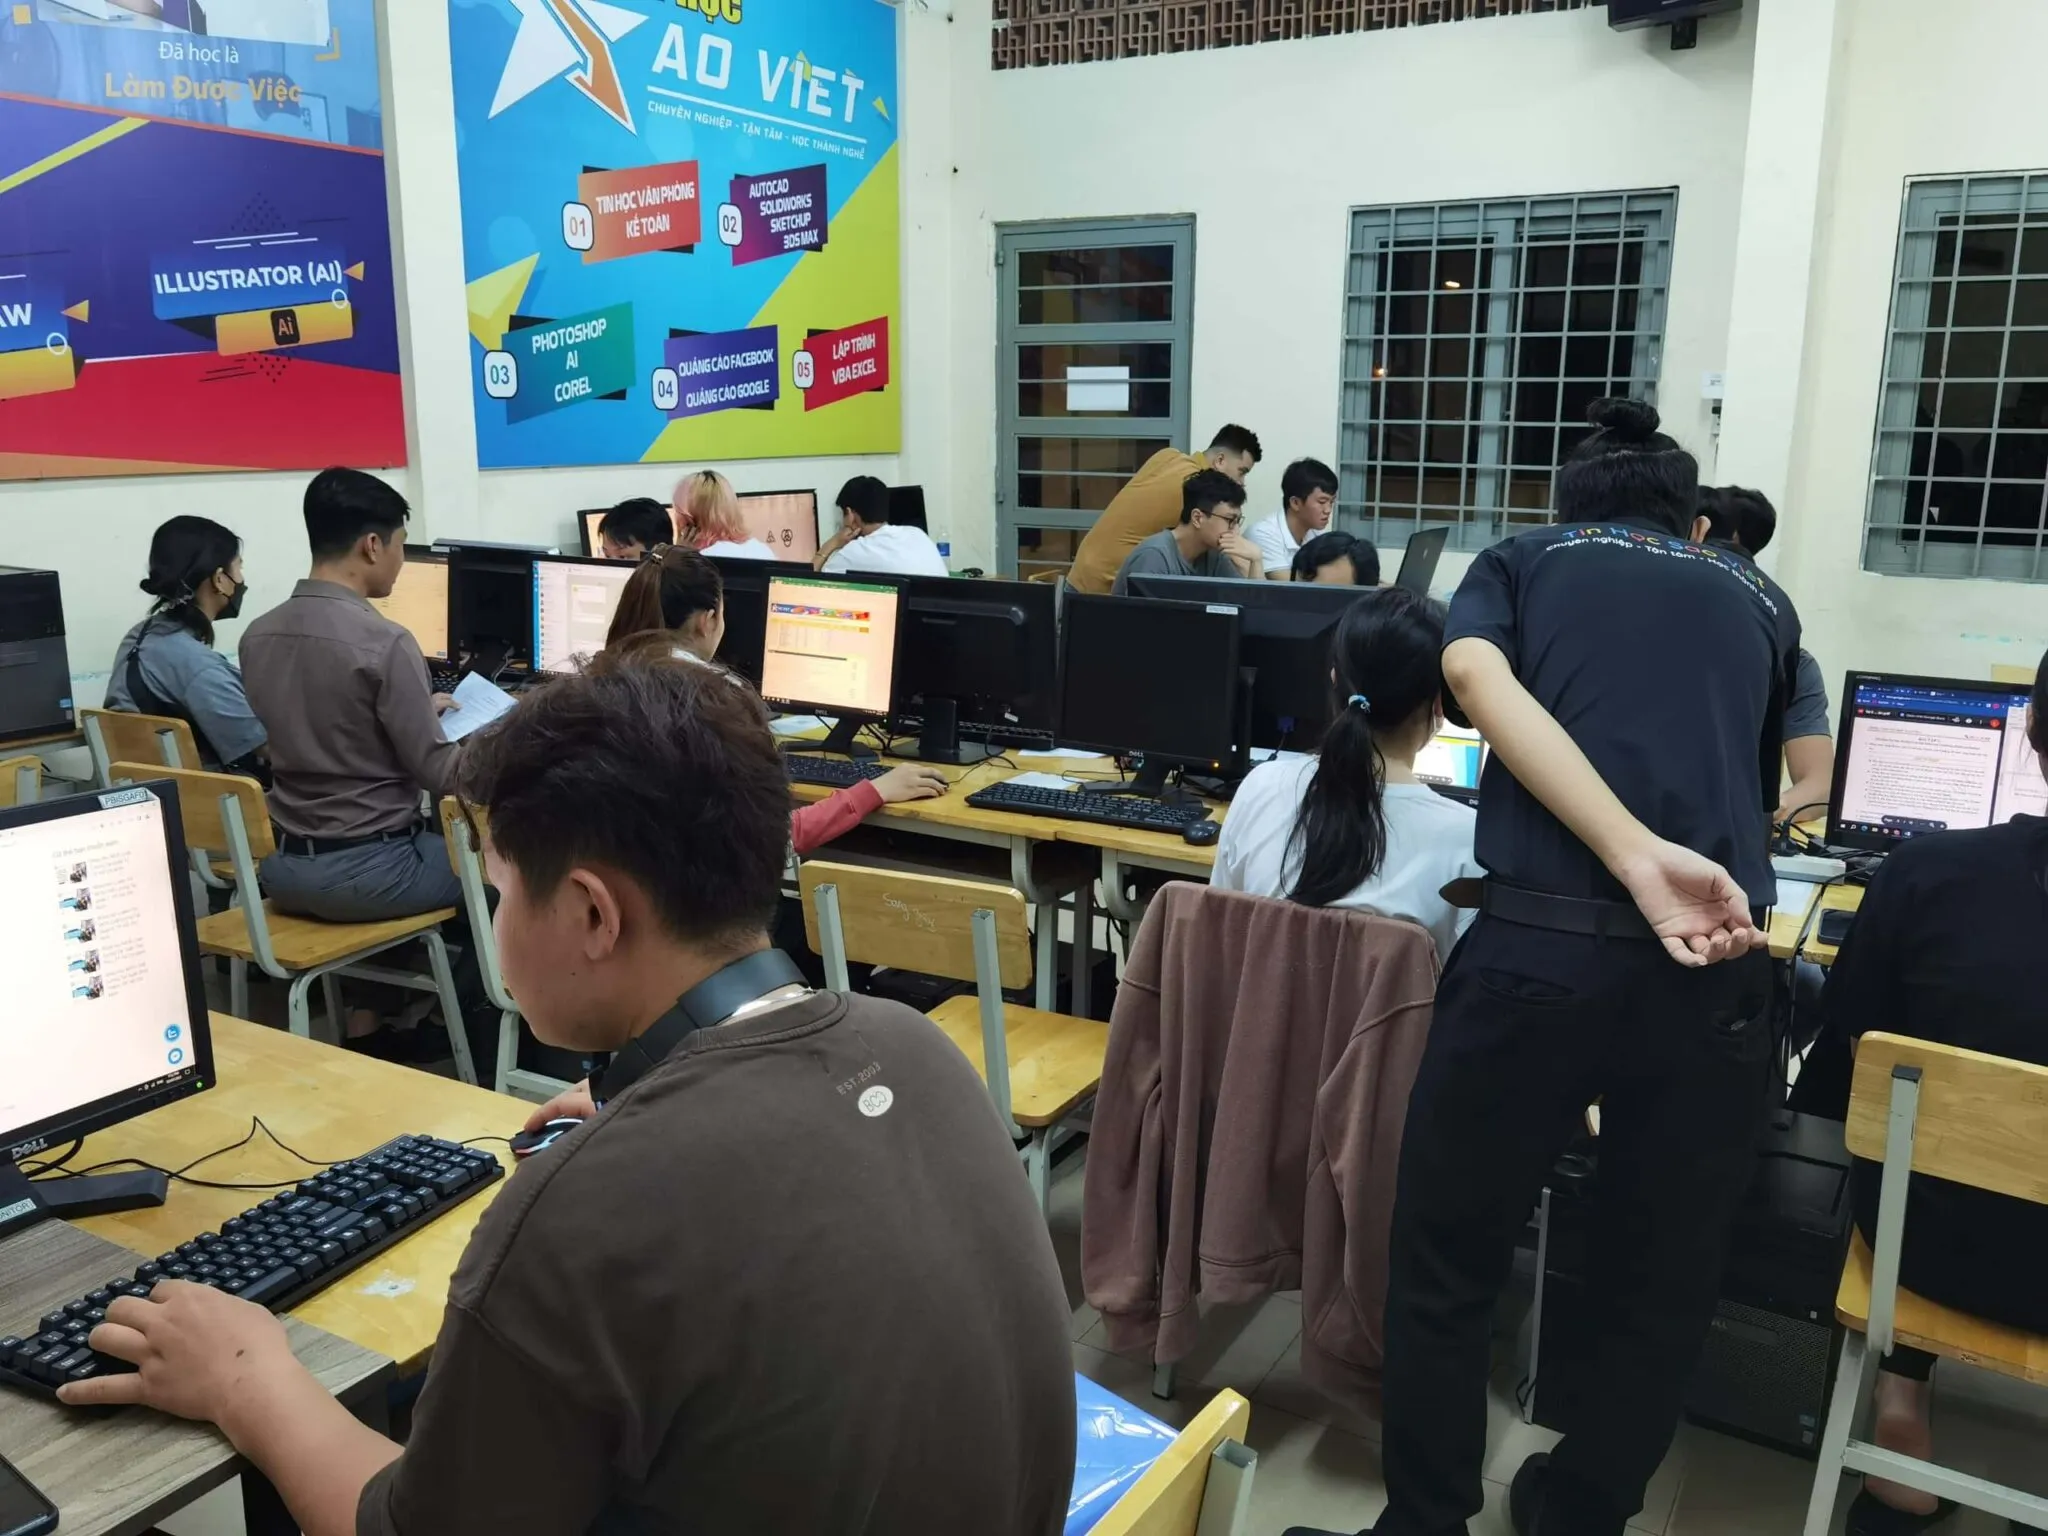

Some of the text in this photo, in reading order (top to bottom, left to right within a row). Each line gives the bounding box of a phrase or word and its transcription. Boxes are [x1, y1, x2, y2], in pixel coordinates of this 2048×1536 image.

[159, 41, 239, 66] Đã học là
[105, 72, 303, 108] Làm Được Việc
[648, 100, 691, 120] CHUYÊN
[694, 111, 732, 130] NGHIỆP
[742, 121, 760, 137] TẬN
[791, 134, 809, 147] HỌC
[749, 178, 789, 199] AUTOCAD
[596, 195, 616, 214] TIN
[616, 190, 637, 213] HỌC
[760, 193, 812, 216] SOLIDWORKS
[569, 216, 586, 237] 01
[722, 214, 737, 233] 02
[770, 212, 812, 233] SKETCHUP
[783, 229, 818, 249] 3DS MAX
[154, 260, 343, 294] ILLUSTRATOR (AI)
[278, 318, 294, 335] Ai
[532, 318, 607, 354] PHOTOSHOP
[566, 350, 579, 370] AI
[730, 348, 774, 369] FACEBOOK
[797, 361, 811, 377] 05
[490, 364, 510, 385] 03
[832, 358, 876, 385] VBA EXCEL
[554, 376, 592, 402] COREL
[657, 380, 673, 398] 04
[737, 379, 770, 399] GOOGLE
[12, 1138, 48, 1160] DELL
